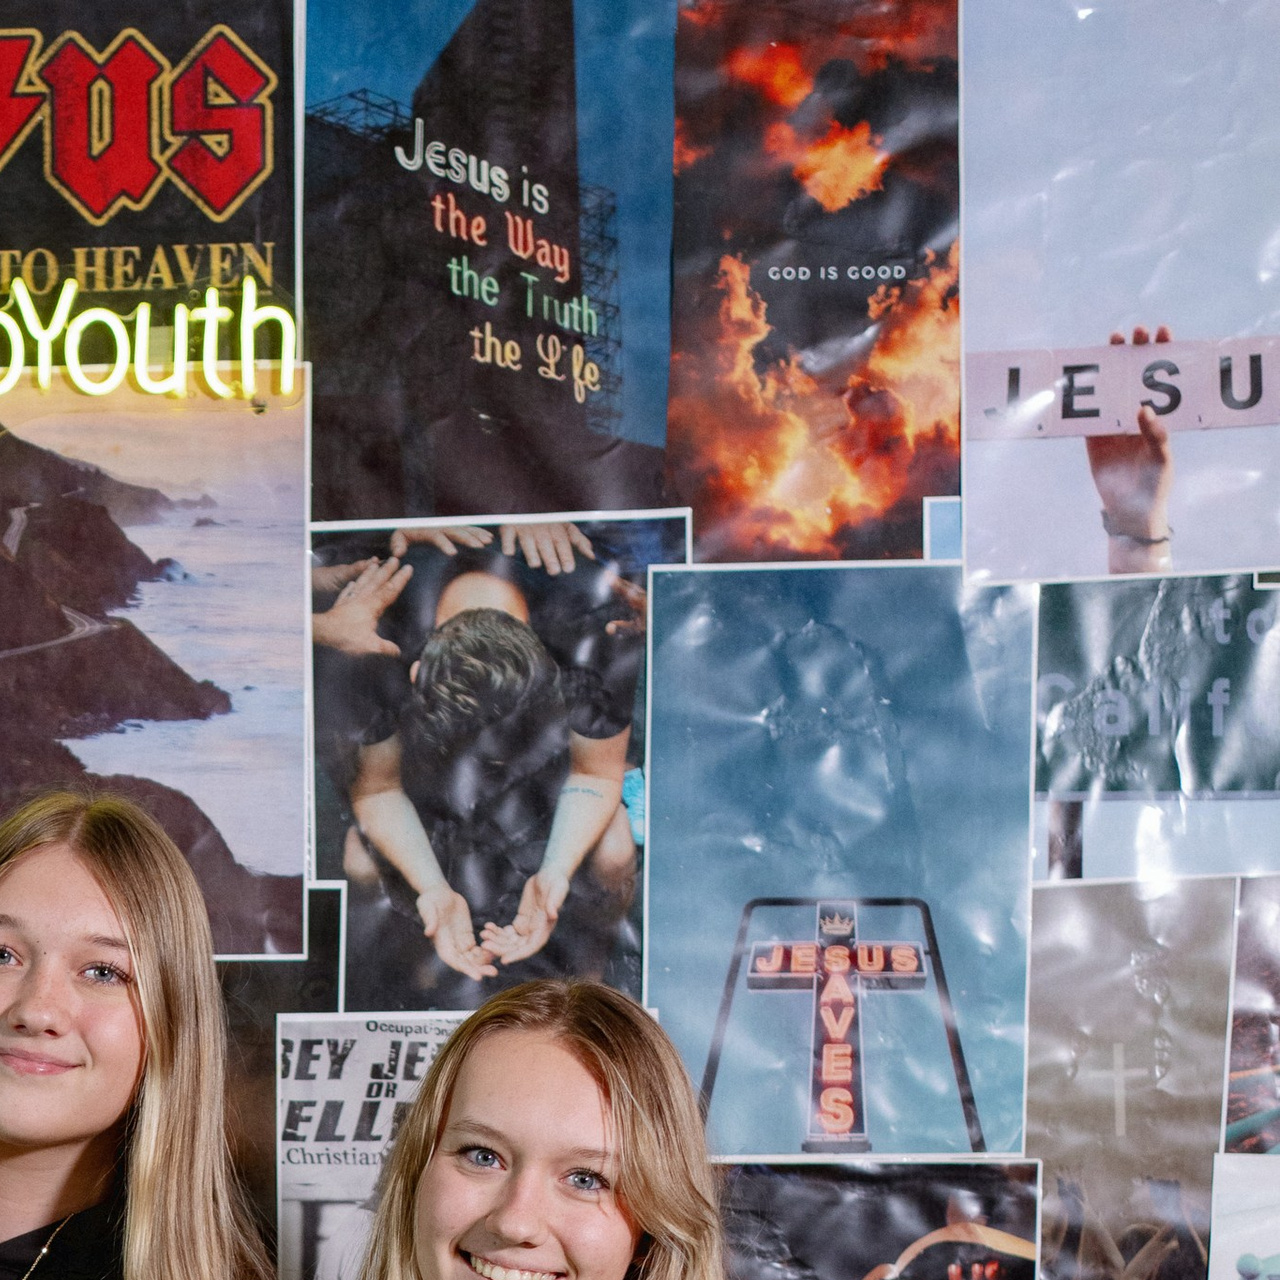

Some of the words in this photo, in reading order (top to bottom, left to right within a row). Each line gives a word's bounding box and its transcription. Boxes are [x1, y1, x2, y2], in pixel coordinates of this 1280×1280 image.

[394, 131, 510, 203] Jesus
[522, 165, 549, 214] is
[431, 193, 487, 247] the
[504, 211, 570, 283] Way
[72, 241, 276, 297] HEAVEN
[447, 255, 500, 307] the
[520, 271, 598, 336] Truth
[768, 266, 811, 281] GOD
[820, 266, 839, 281] IS
[847, 265, 907, 280] GOOD
[470, 321, 522, 371] the
[755, 944, 919, 974] JESUS
[365, 1081, 398, 1098] OR
